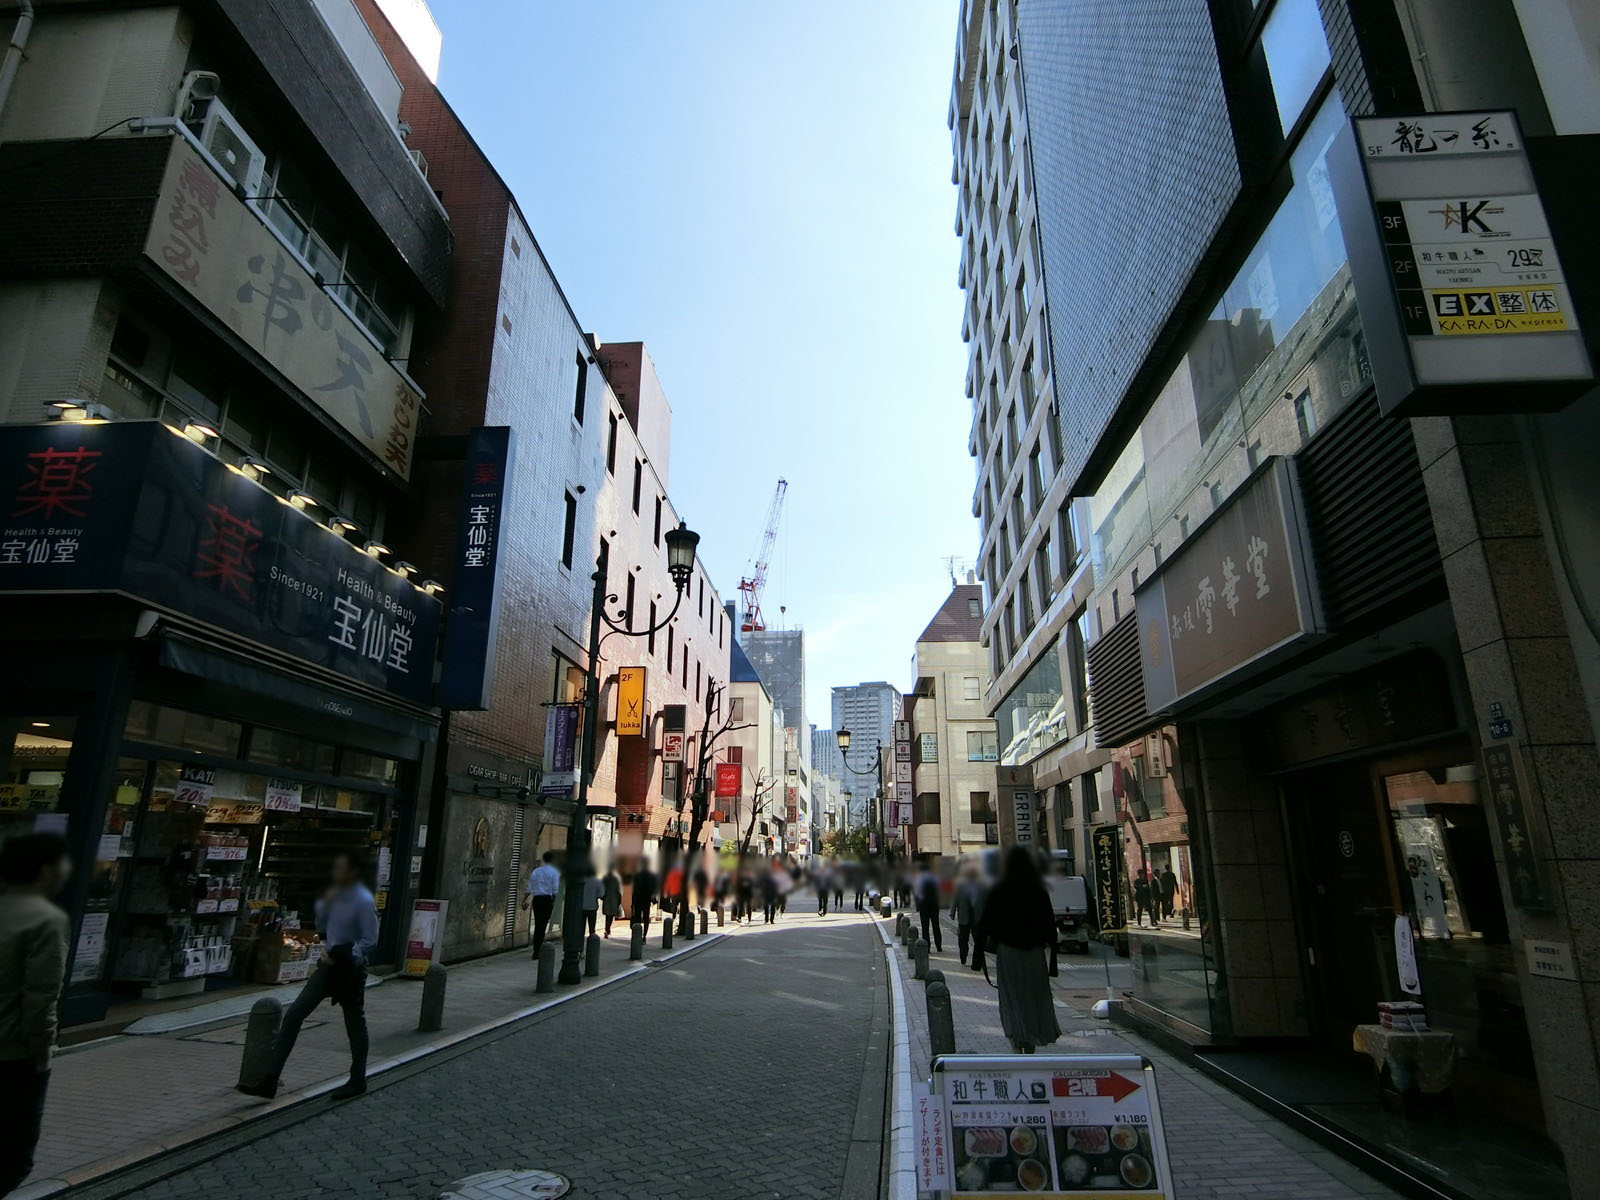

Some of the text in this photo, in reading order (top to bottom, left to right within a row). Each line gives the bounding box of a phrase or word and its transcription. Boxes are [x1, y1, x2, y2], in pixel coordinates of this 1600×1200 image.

[1368, 146, 1383, 155] 5F
[1384, 216, 1402, 229] 3F
[1395, 261, 1413, 273] 2F
[1405, 306, 1425, 320] 1F
[12, 446, 103, 519] 薬
[4, 526, 84, 538] Health & Beauty
[464, 504, 490, 568] 宝仙堂
[1, 538, 80, 565] 宝仙堂
[194, 502, 264, 604] 薬
[337, 567, 418, 628] Health & Beauty
[327, 595, 415, 674] 宝仙堂
[621, 673, 634, 682] 2F
[620, 721, 641, 729] tukka
[1491, 723, 1509, 736] 10-6
[224, 850, 241, 859] 976
[952, 1078, 1029, 1101] 和牛職人
[1013, 1115, 1046, 1125] ¥1,280
[1114, 1114, 1147, 1124] ¥1,180
[920, 1098, 932, 1188] デザートが付きます
[933, 1109, 945, 1176] ランチ定食には
